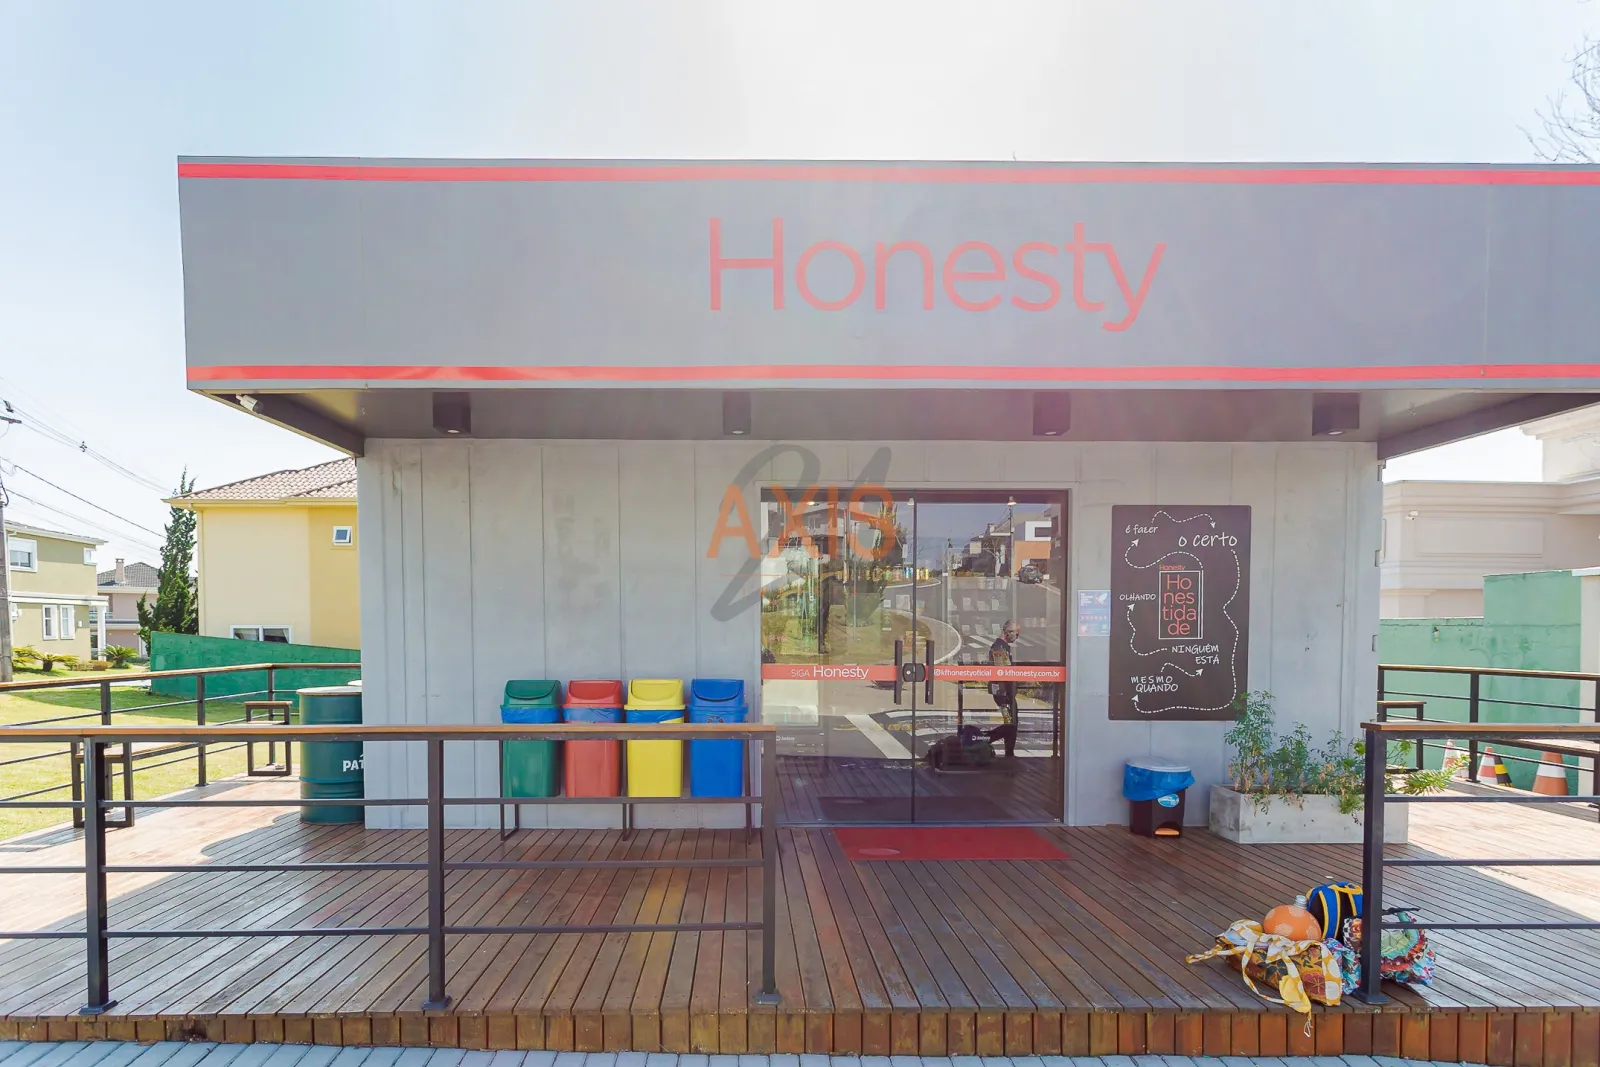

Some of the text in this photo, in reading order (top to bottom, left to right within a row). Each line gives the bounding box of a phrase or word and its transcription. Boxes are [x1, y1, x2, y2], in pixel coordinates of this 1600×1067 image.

[709, 217, 1167, 332] Honesty
[1133, 524, 1158, 535] fazer
[1192, 532, 1238, 547] certo
[1119, 593, 1157, 601] OLHANDO
[1171, 643, 1220, 655] NINGUÉM
[1195, 654, 1220, 665] ESTÁ
[790, 665, 870, 680] SIGA Honesty
[1130, 675, 1173, 684] MESMO
[1135, 683, 1179, 693] QUANDO
